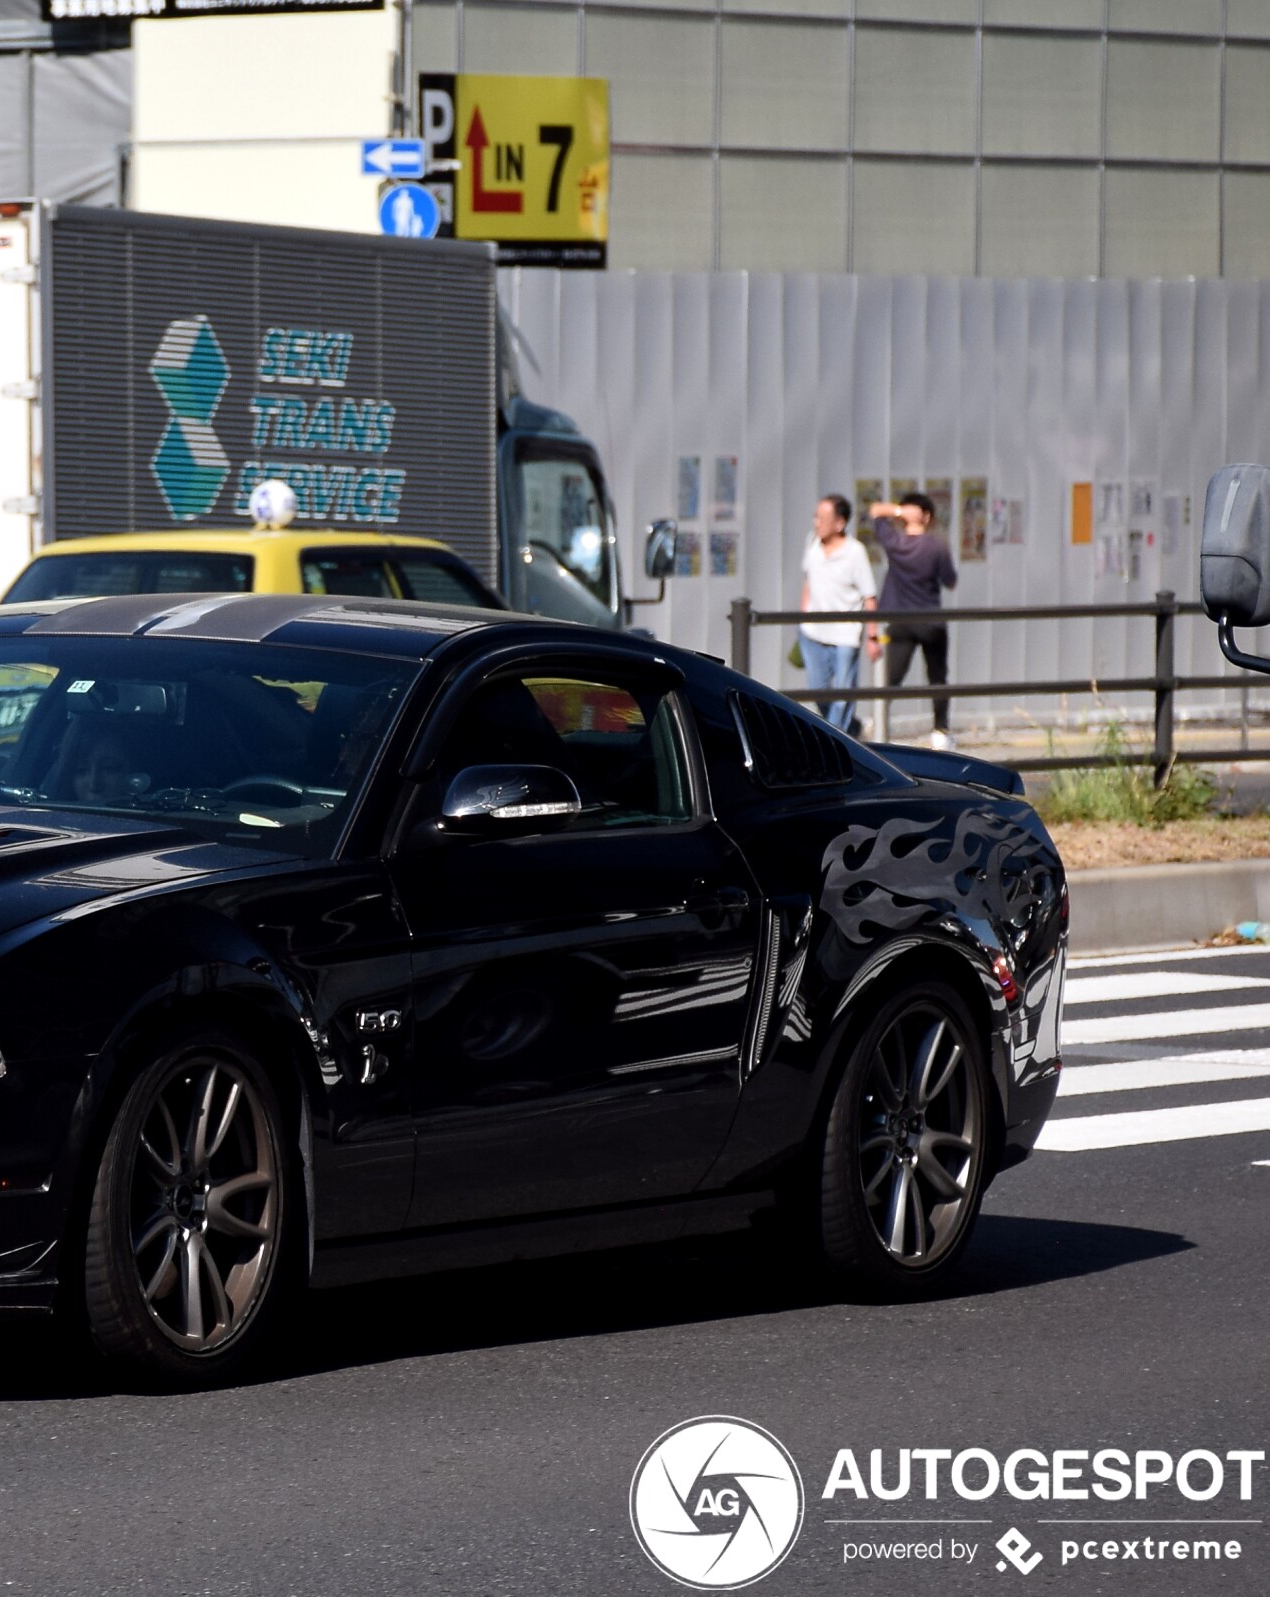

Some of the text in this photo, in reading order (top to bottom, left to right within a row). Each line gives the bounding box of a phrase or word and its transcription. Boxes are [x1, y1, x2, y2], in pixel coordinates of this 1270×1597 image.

[422, 88, 454, 173] P
[495, 123, 573, 214] IN 7
[257, 328, 354, 387] SEKI
[250, 393, 396, 453] TRANS
